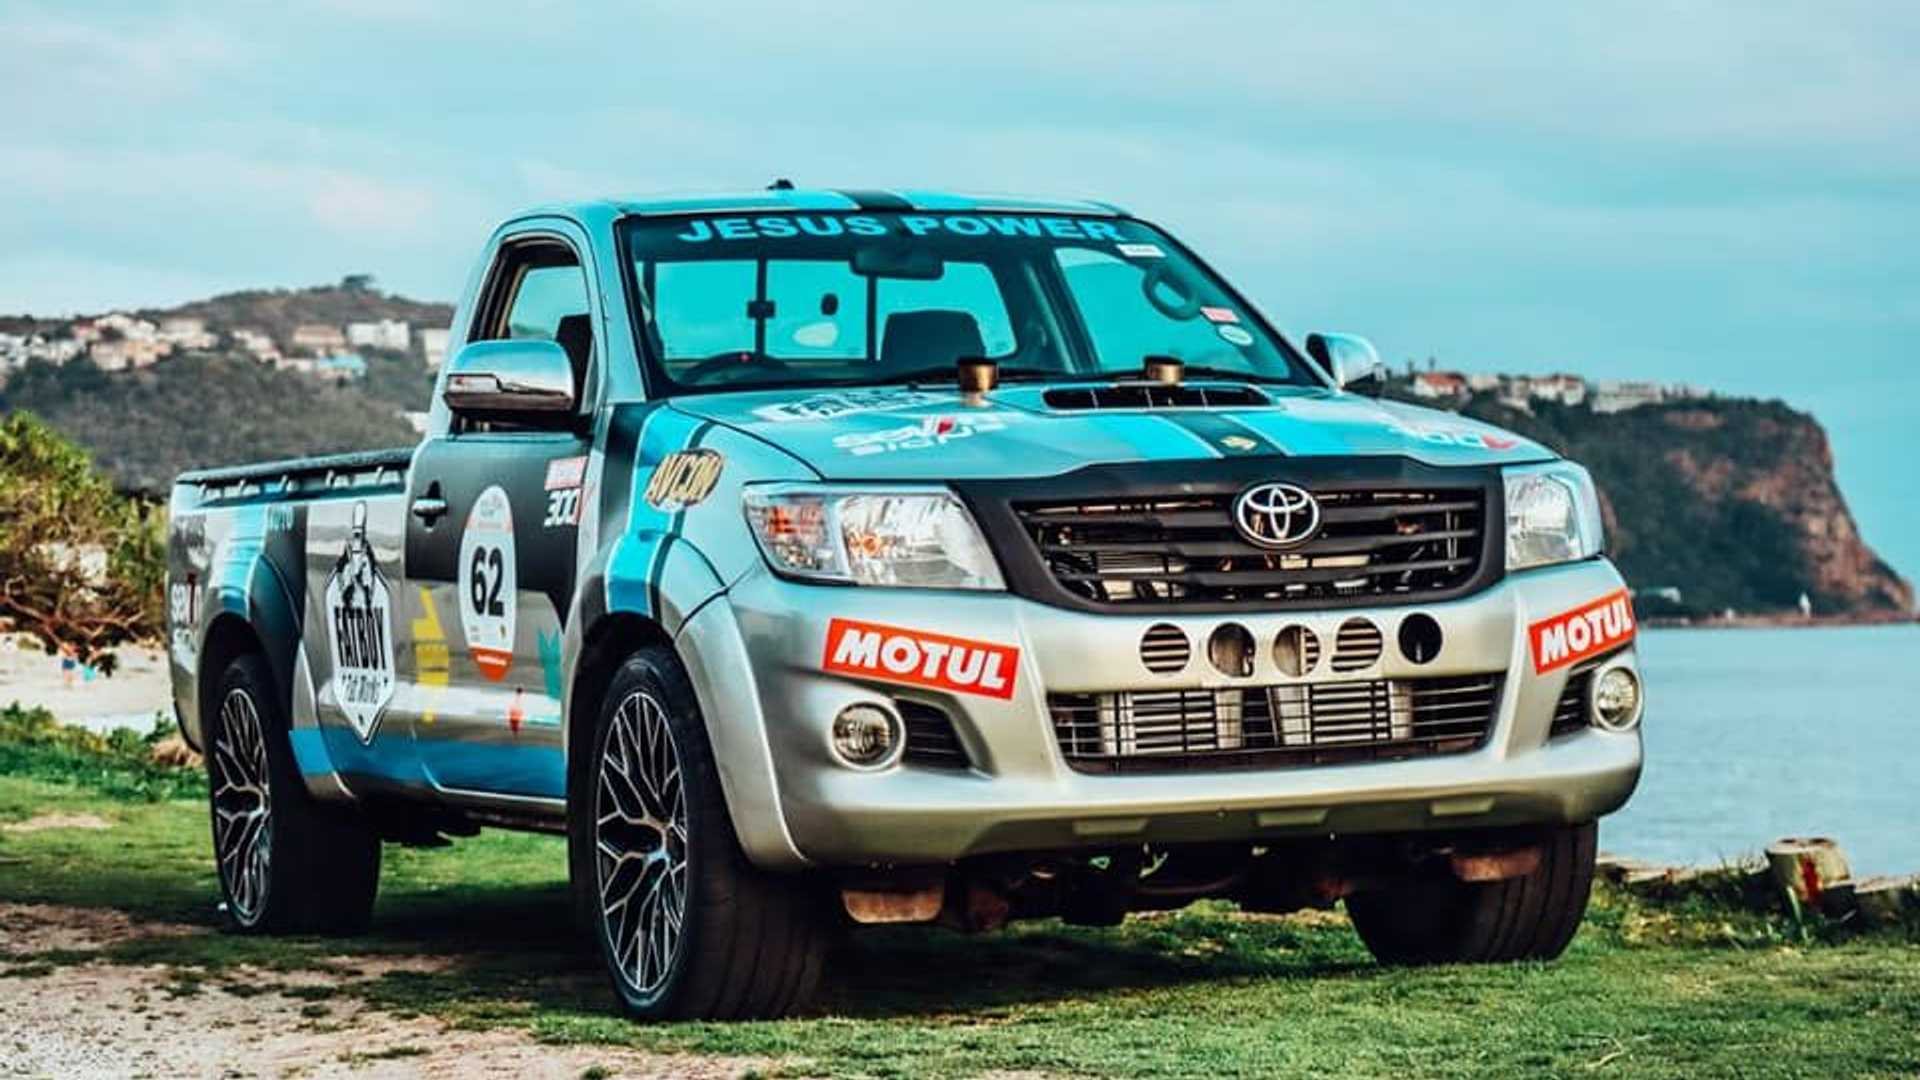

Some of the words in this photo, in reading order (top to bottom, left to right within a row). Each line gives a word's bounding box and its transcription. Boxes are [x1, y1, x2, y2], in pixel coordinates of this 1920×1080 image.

[676, 215, 888, 242] JESUS
[900, 216, 1128, 242] POWER
[544, 489, 580, 527] 300
[470, 546, 505, 617] 62
[333, 606, 387, 671] FATBOY
[832, 628, 1007, 690] MOTUL
[1540, 597, 1633, 666] MOTUL
